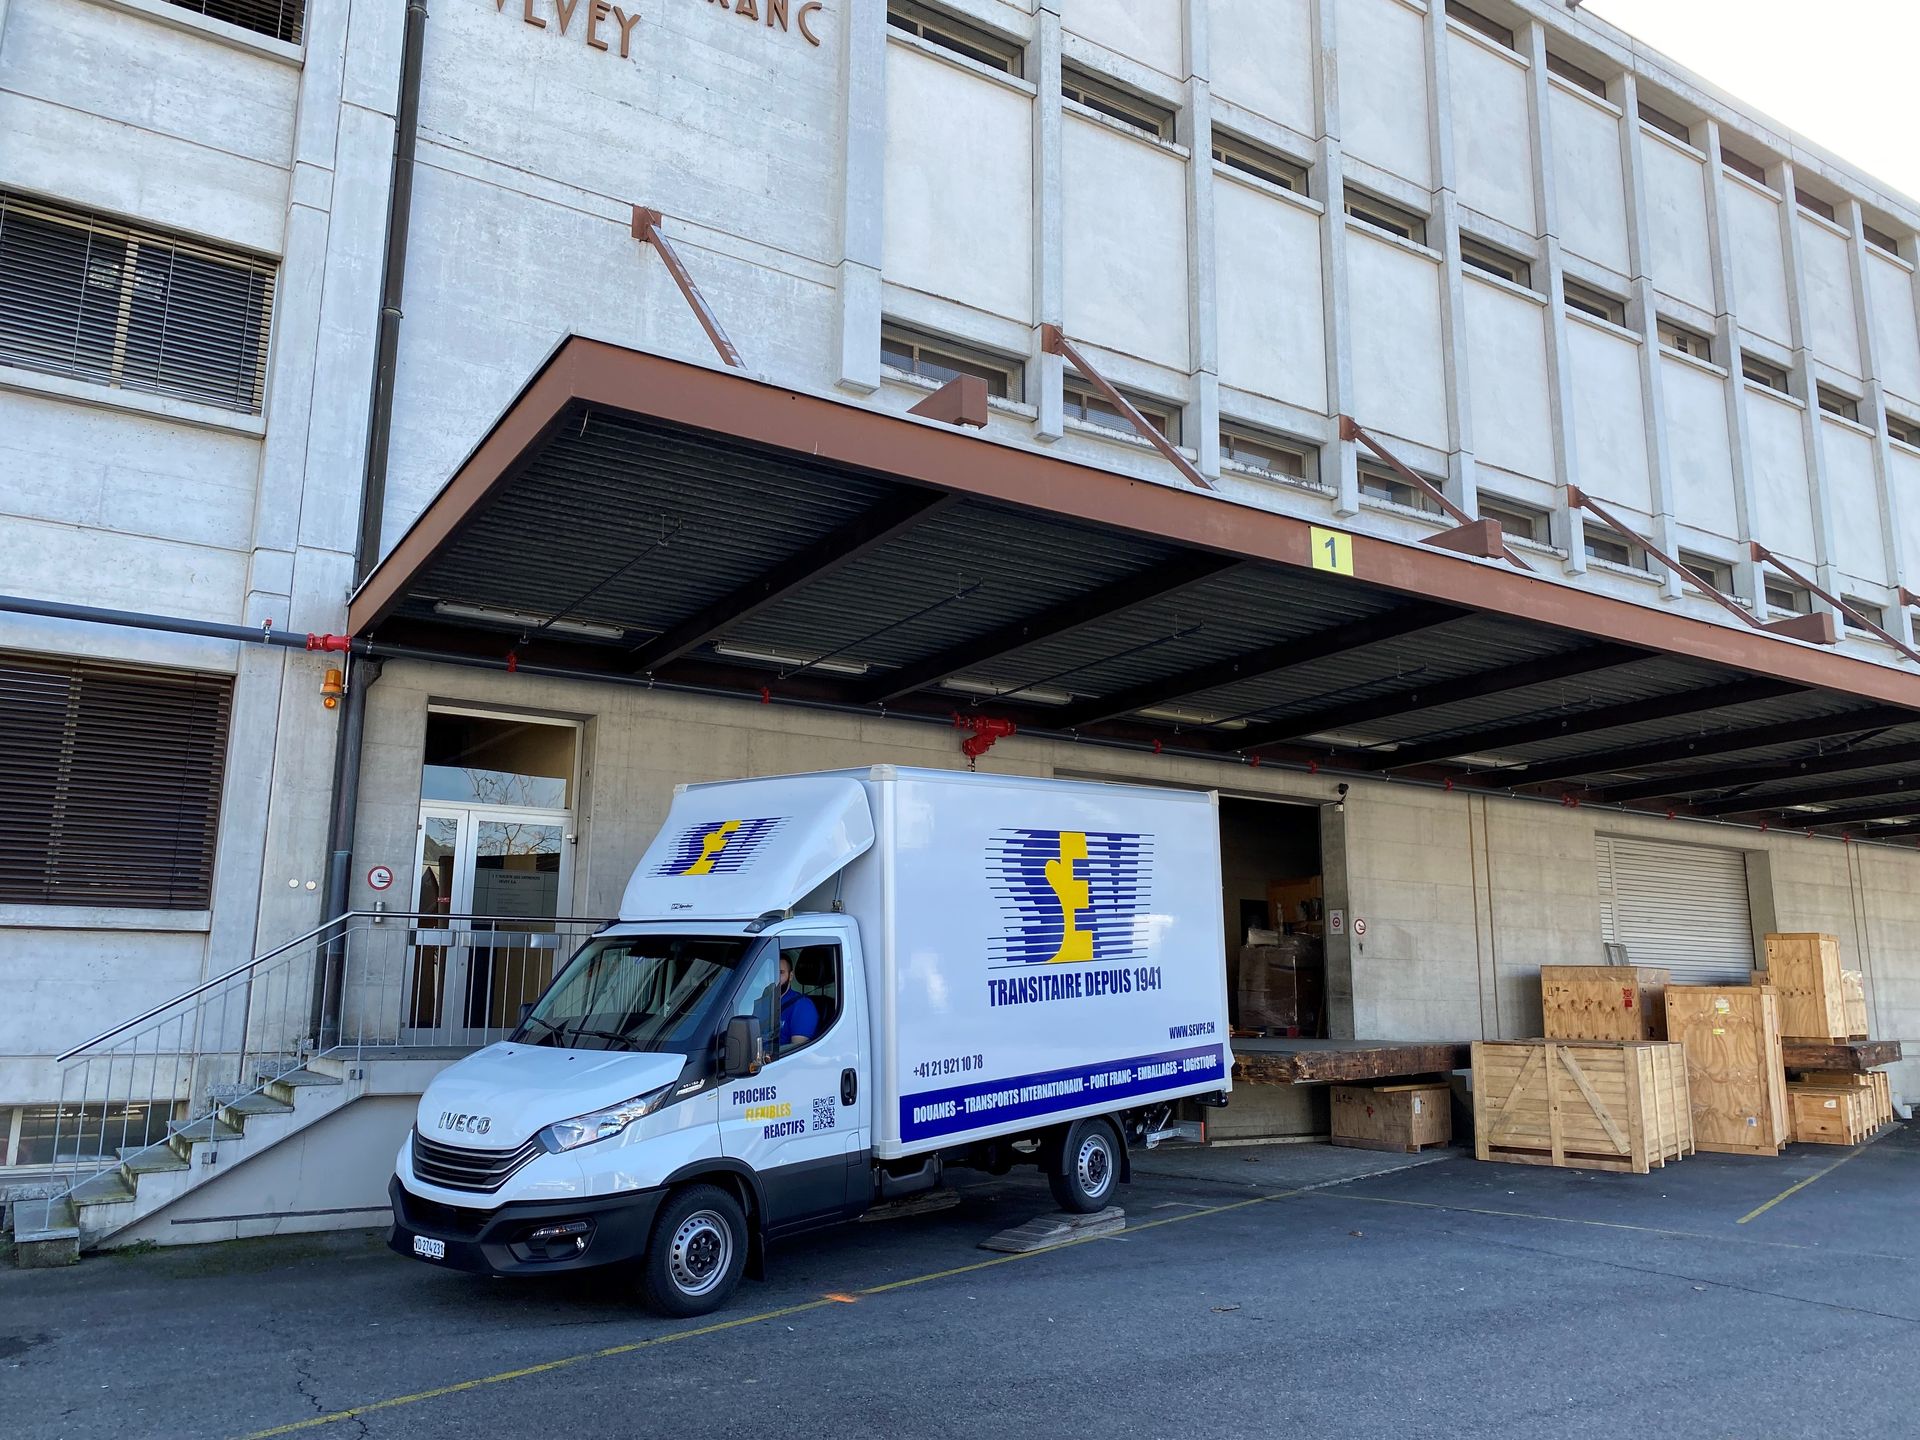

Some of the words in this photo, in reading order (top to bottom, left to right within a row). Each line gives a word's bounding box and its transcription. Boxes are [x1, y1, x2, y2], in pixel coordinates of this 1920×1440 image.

[1324, 536, 1337, 568] 1
[988, 972, 1082, 1007] TRANSITAIRE
[1085, 968, 1132, 997] DEPUIS
[1134, 966, 1162, 992] 1941
[1169, 1021, 1215, 1039] WWW.SEVPF.CH
[913, 1062, 930, 1078] +41
[931, 1060, 942, 1076] 21
[943, 1057, 960, 1074] 921
[961, 1055, 972, 1071] 10
[973, 1054, 983, 1069] 78
[732, 1085, 777, 1106] PROCHES
[913, 1100, 956, 1124] DOUANES
[964, 1088, 1019, 1114] TRANSPORTS
[1020, 1077, 1084, 1103] INTERNATIONAUX
[1090, 1073, 1108, 1090] PORT
[1109, 1069, 1132, 1086] FRANC
[1137, 1060, 1178, 1081] EMBALLAGES
[1183, 1054, 1217, 1073] LOGISTIQUE
[438, 1111, 492, 1135] IVECO
[745, 1103, 791, 1121] FLEXIBLES
[763, 1119, 805, 1140] REACTIFS
